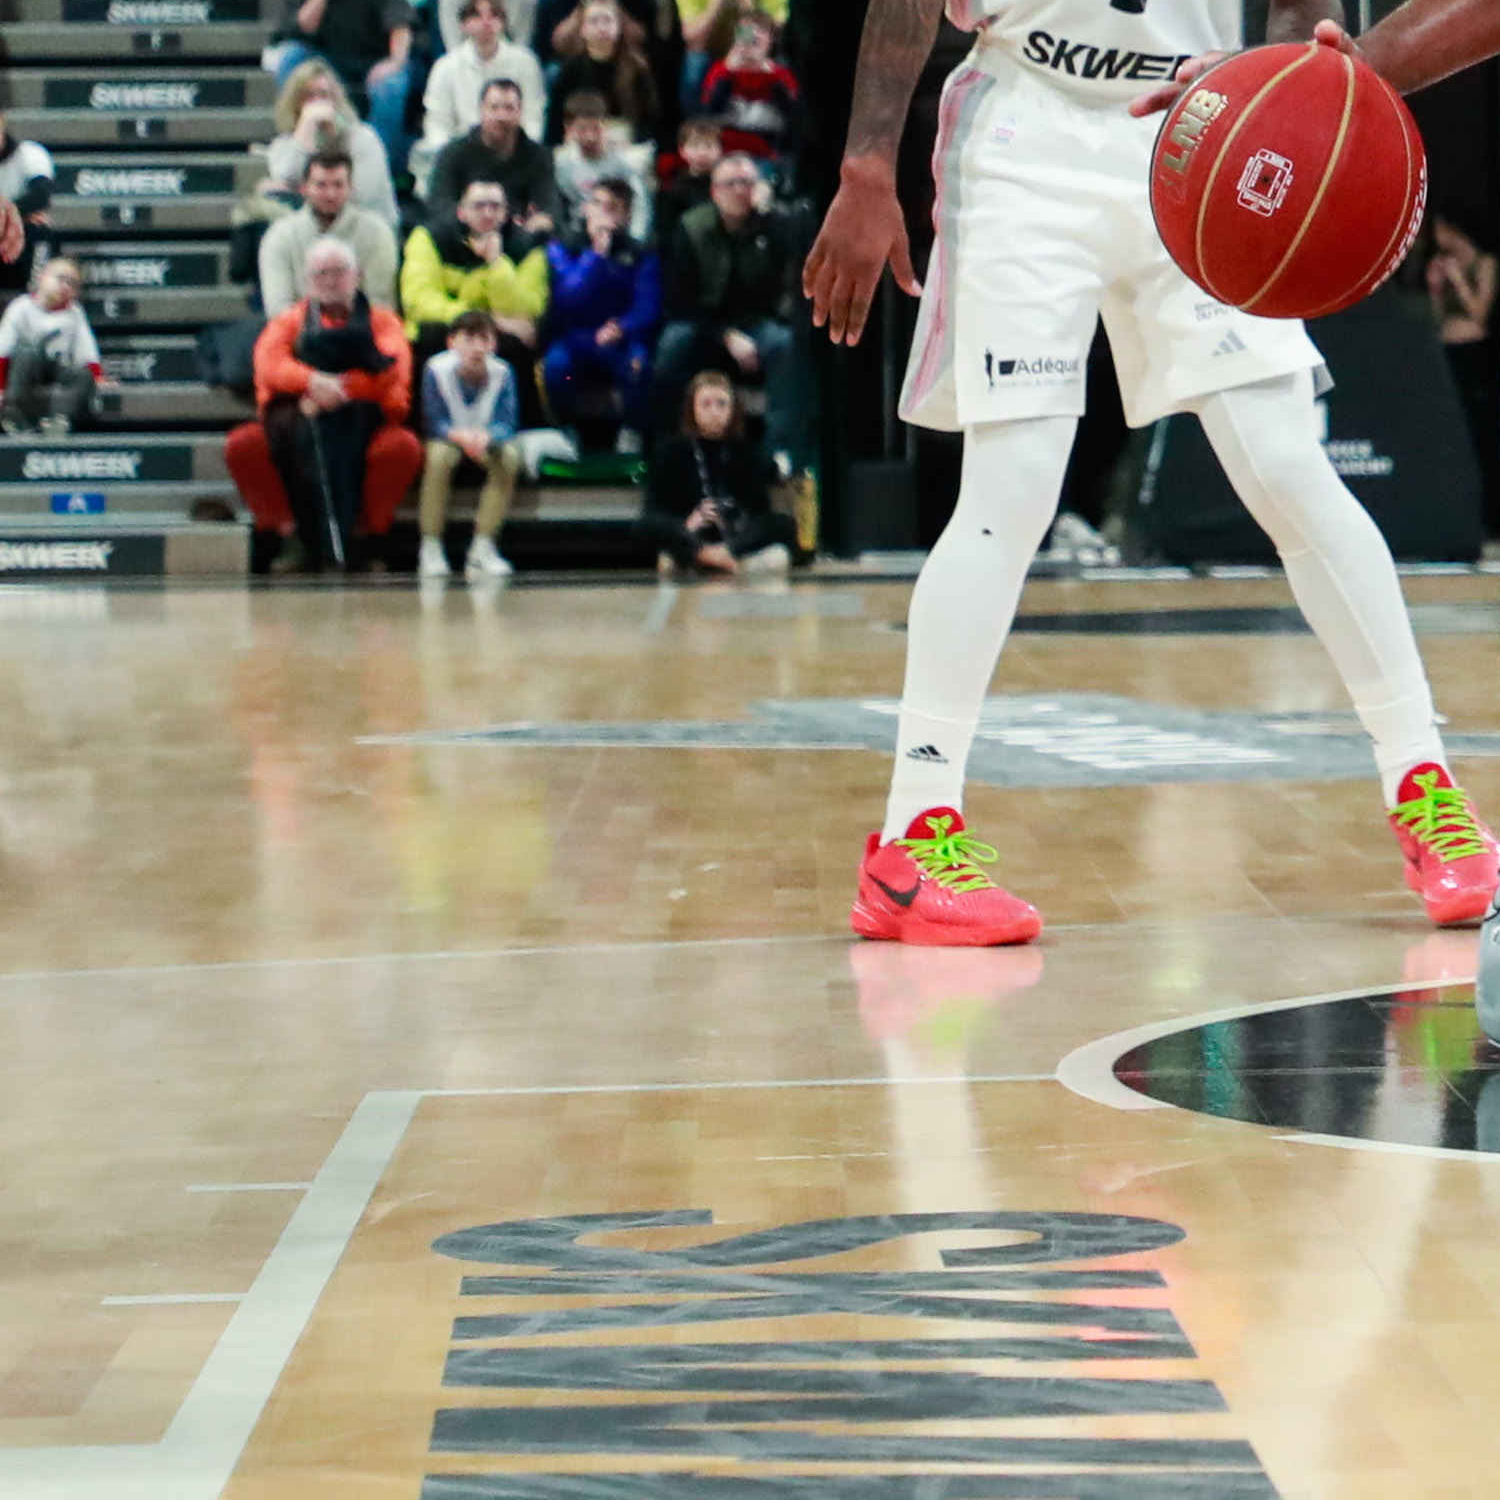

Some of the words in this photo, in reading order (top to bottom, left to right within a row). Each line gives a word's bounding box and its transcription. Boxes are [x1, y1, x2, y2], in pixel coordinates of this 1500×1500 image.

[90, 81, 198, 109] SKWEEK
[1162, 88, 1224, 176] LNB
[75, 168, 187, 196] SKWEEK
[22, 450, 142, 480] SKWEEK
[420, 1206, 1282, 1500] SKW
